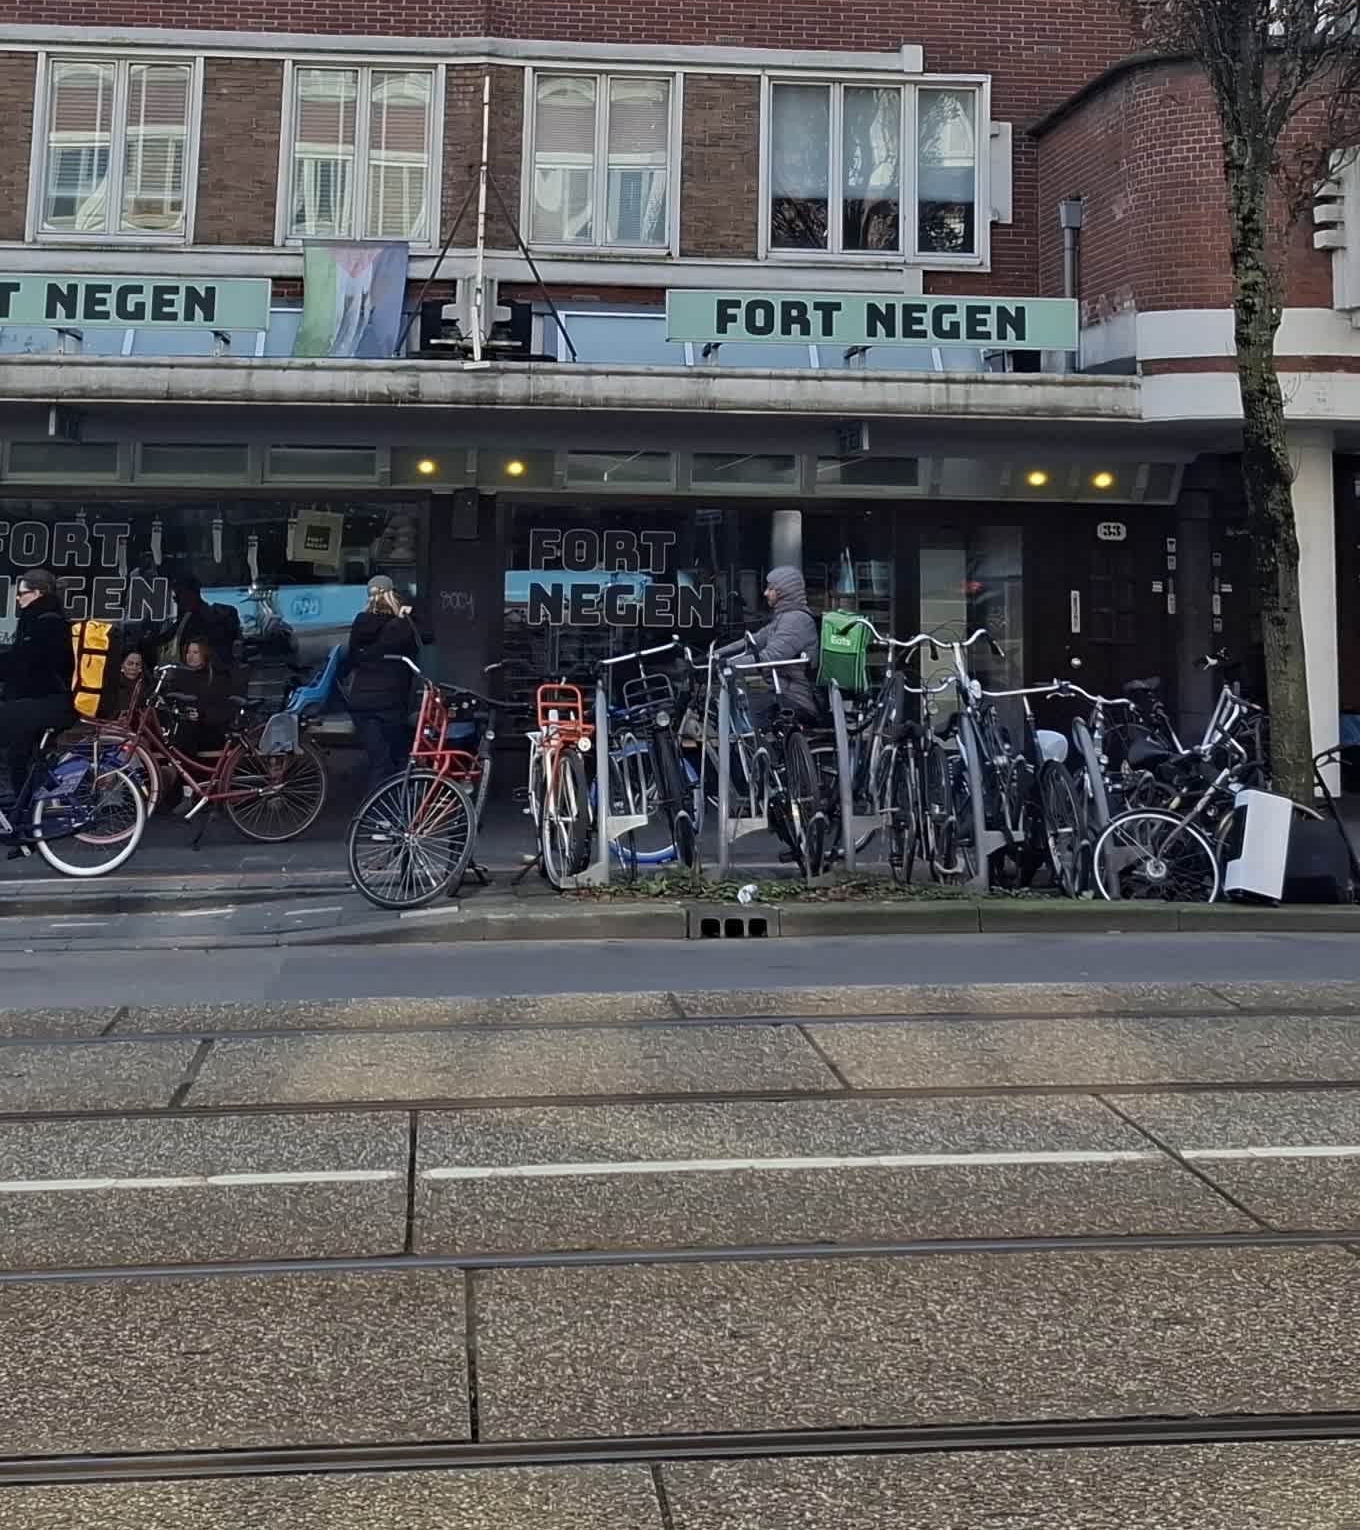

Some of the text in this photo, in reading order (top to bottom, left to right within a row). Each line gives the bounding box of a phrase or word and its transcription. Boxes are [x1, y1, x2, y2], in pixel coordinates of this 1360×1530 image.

[44, 282, 217, 323] NEGEN
[716, 298, 1027, 341] FORT NEGEN
[529, 528, 676, 575] FORT
[1102, 524, 1122, 537] 33
[527, 581, 715, 629] NEGEN
